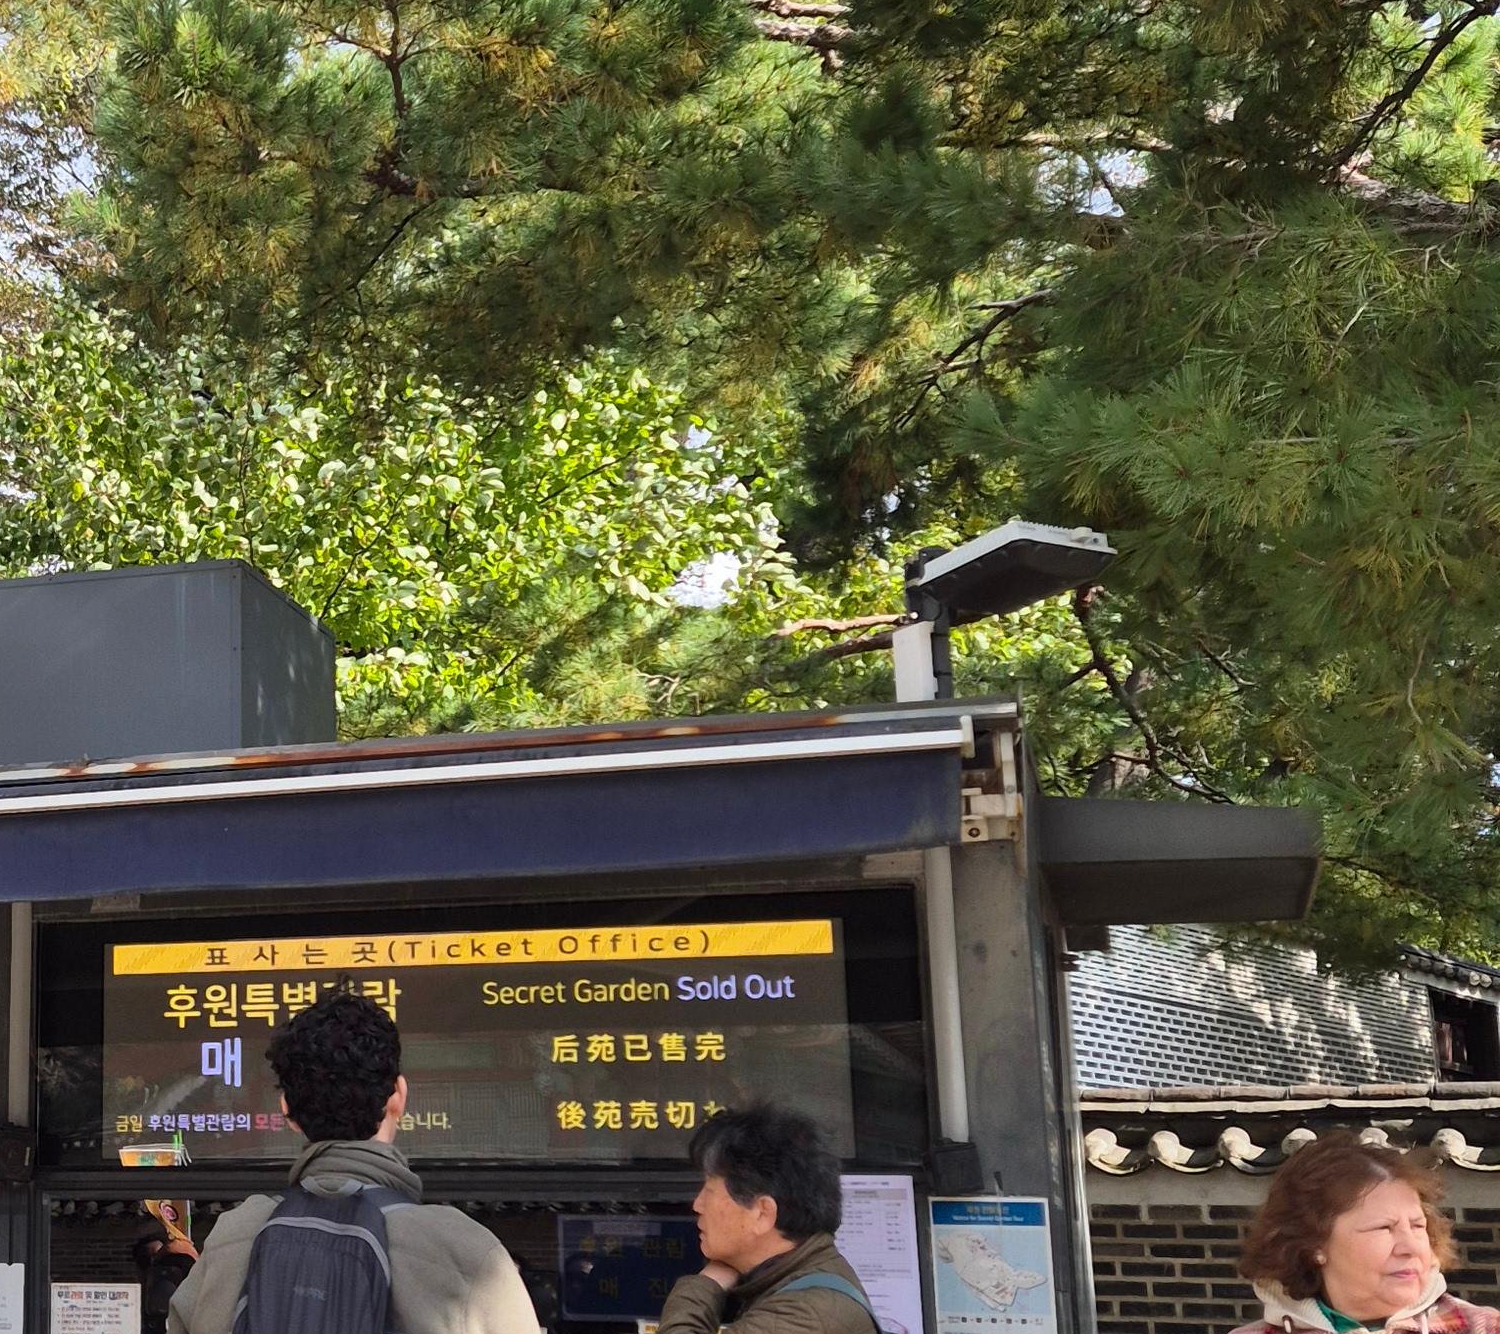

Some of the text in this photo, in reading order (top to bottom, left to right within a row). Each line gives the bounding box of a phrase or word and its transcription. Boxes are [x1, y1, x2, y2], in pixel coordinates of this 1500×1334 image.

[205, 947, 230, 966] 표
[558, 930, 710, 954] Office)
[164, 978, 402, 1029] 후원특별람
[483, 974, 796, 1006] Secret Garden Sold Out
[201, 1036, 242, 1088] 매
[551, 1031, 727, 1064] 后苑已售完
[115, 1114, 143, 1133] 금일
[148, 1113, 251, 1132] 후원특별관람의
[397, 1111, 452, 1131] 습니다.
